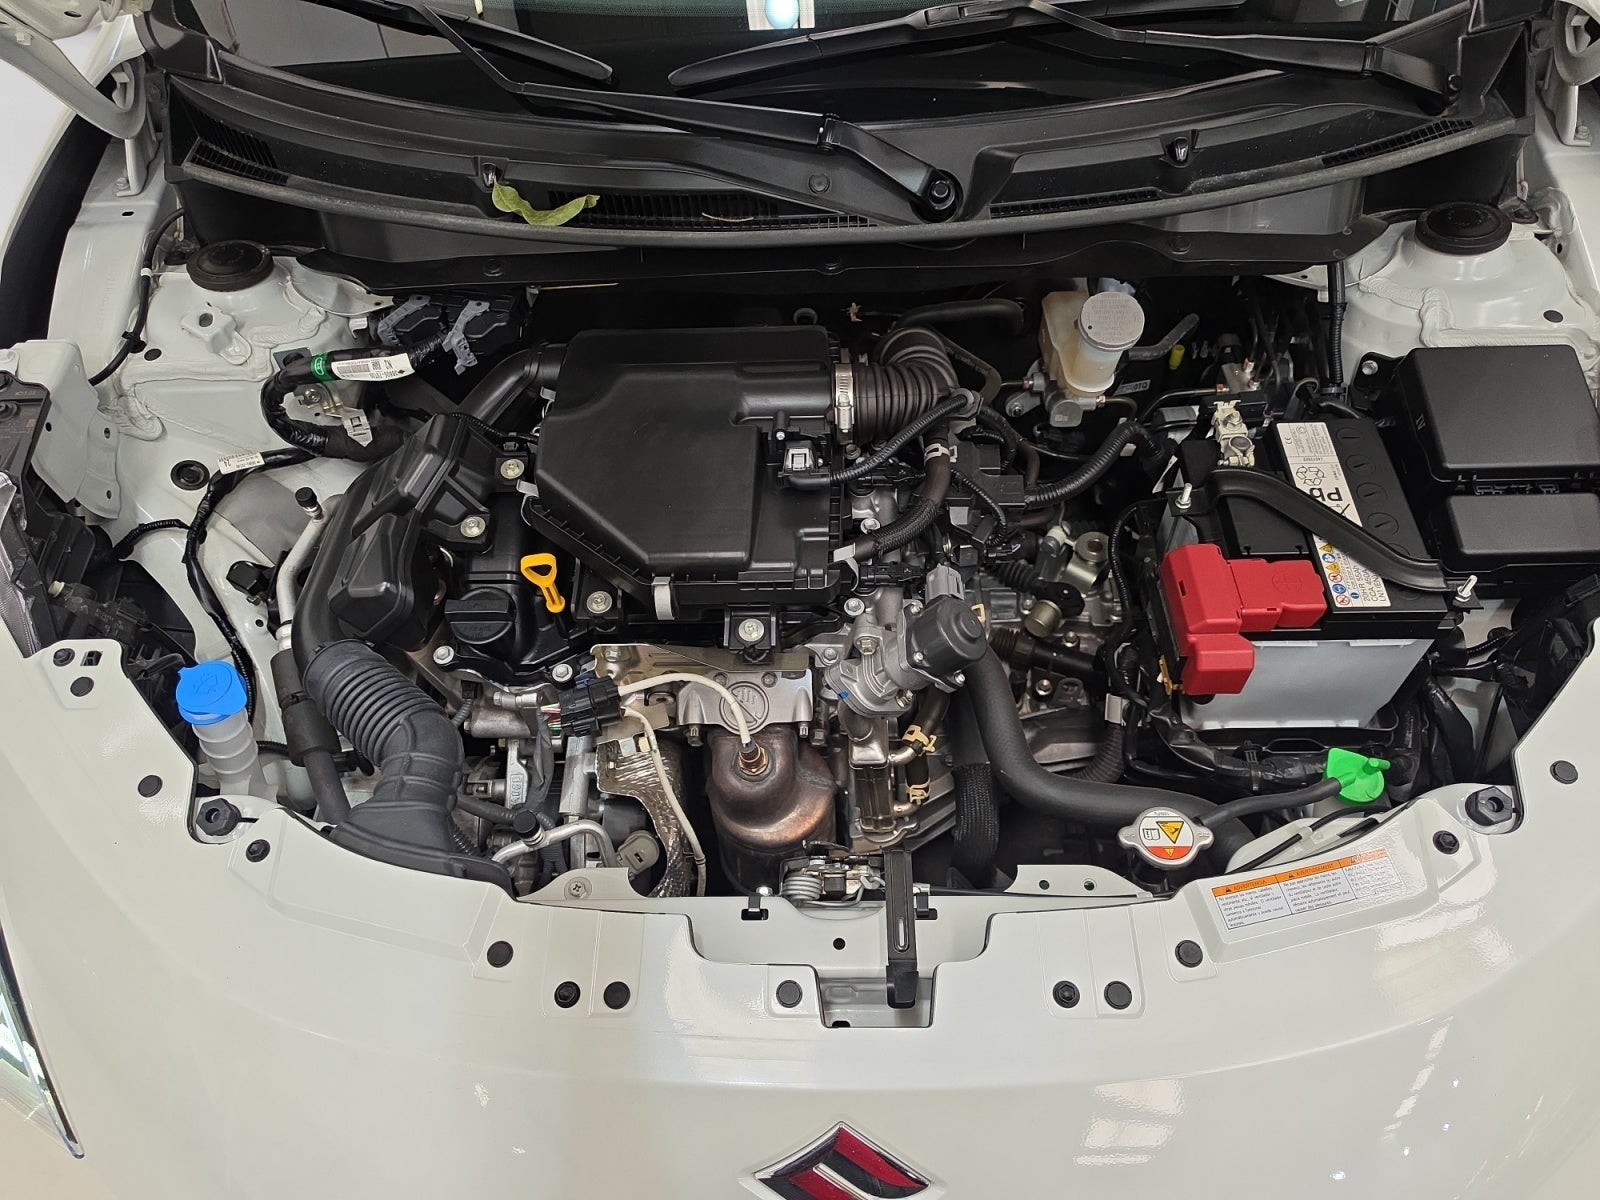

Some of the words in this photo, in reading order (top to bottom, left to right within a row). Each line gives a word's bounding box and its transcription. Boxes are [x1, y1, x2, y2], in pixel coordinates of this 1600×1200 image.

[1309, 487, 1343, 502] Pb
[1358, 583, 1370, 601] 20HR
[1368, 586, 1378, 602] CCA
